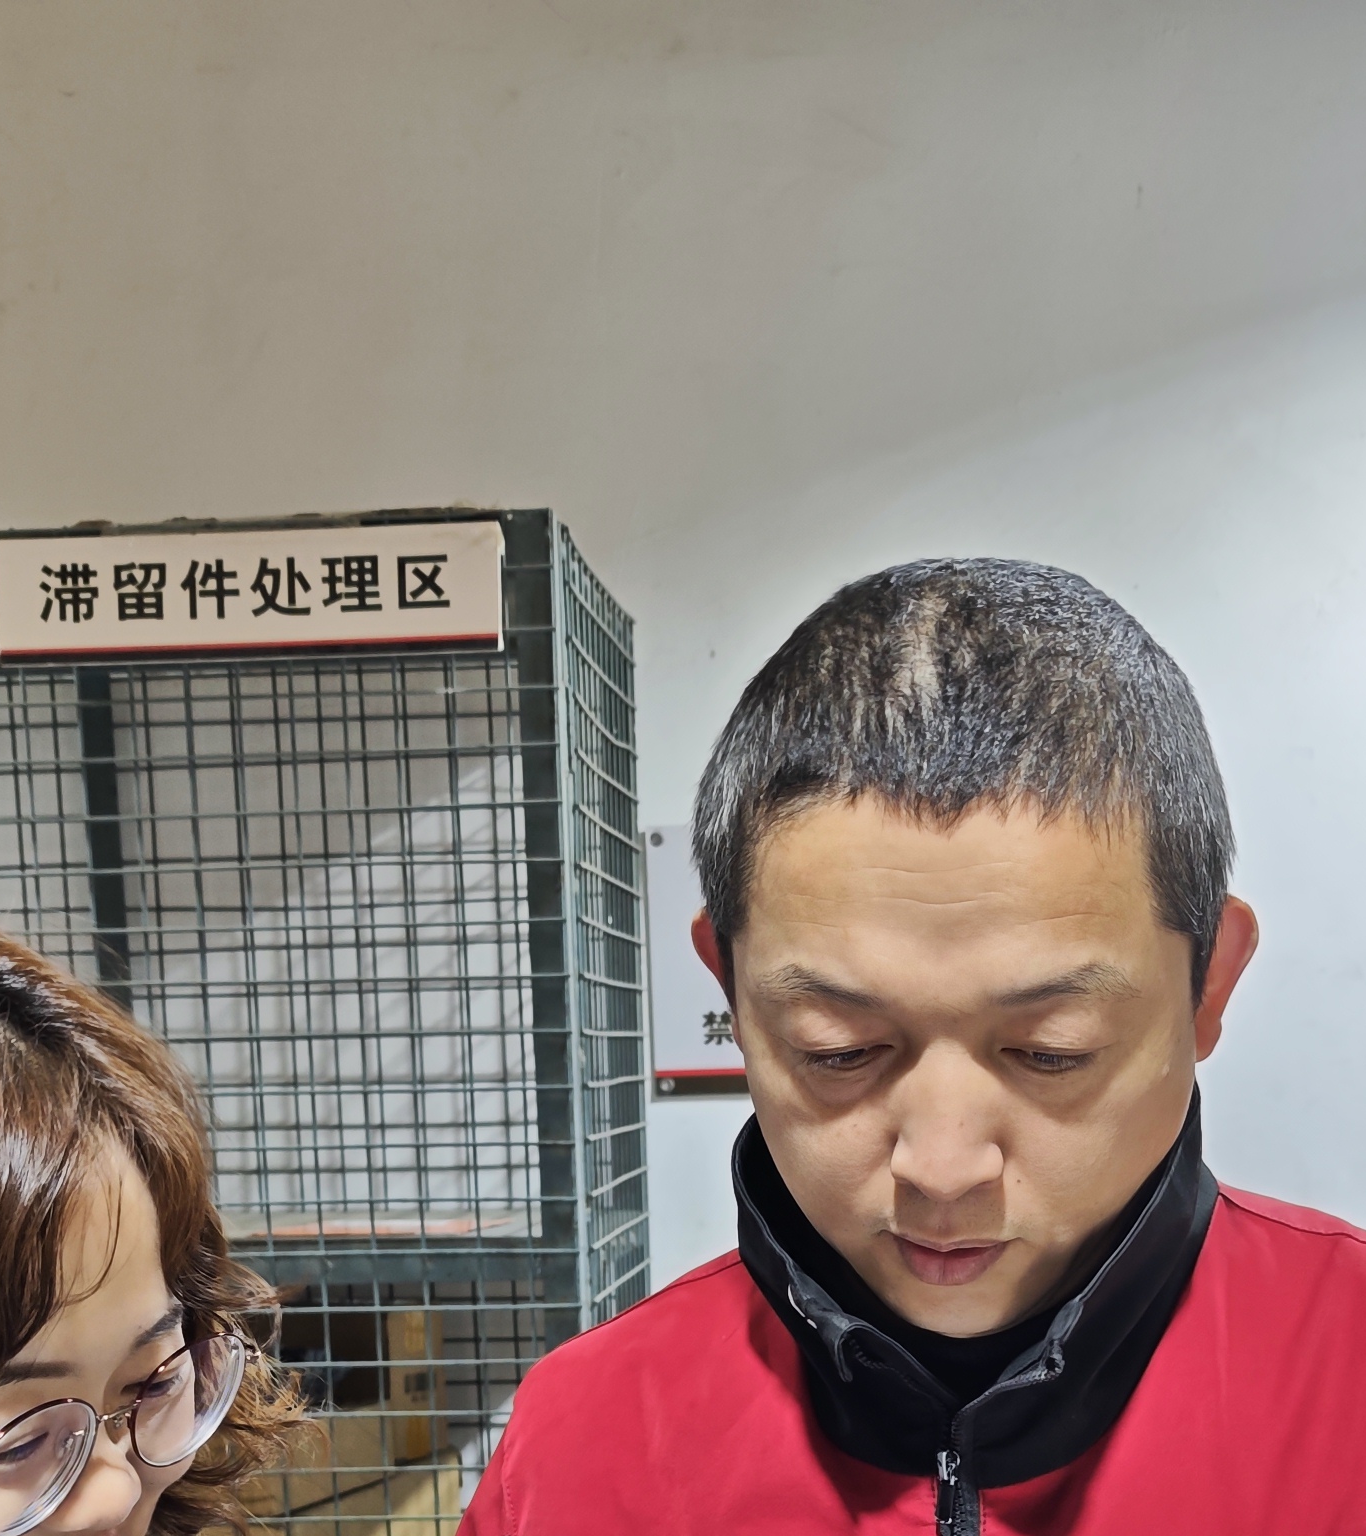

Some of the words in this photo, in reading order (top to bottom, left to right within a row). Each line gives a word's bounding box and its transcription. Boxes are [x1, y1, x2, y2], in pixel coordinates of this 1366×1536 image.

[39, 553, 451, 624] 滞留件处理区
[702, 1010, 734, 1046] 禁
